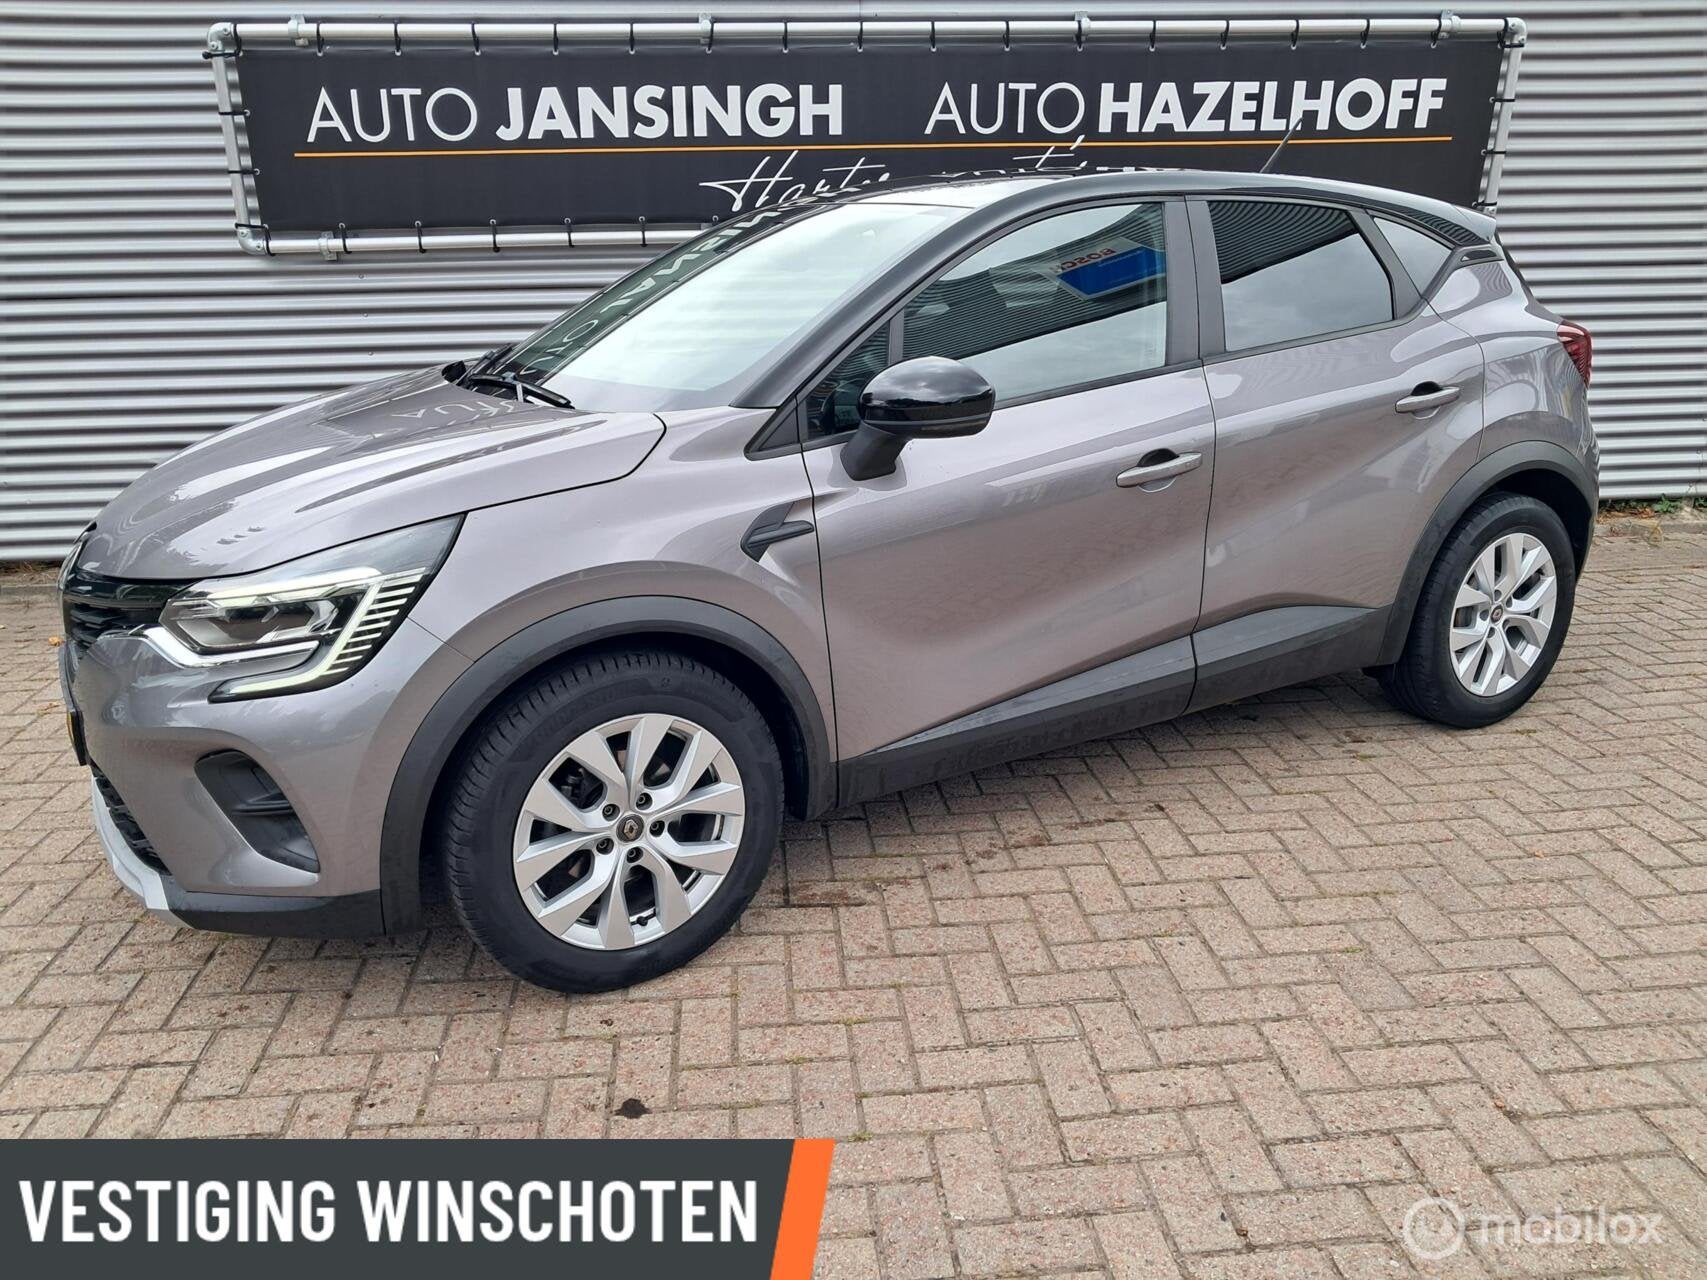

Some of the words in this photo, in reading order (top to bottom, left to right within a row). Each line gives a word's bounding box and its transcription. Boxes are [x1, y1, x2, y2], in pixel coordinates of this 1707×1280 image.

[306, 86, 478, 143] AUTO
[495, 83, 843, 141] JANSINGH
[924, 81, 1085, 135] AUTO
[1098, 77, 1448, 134] HAZELHOFF
